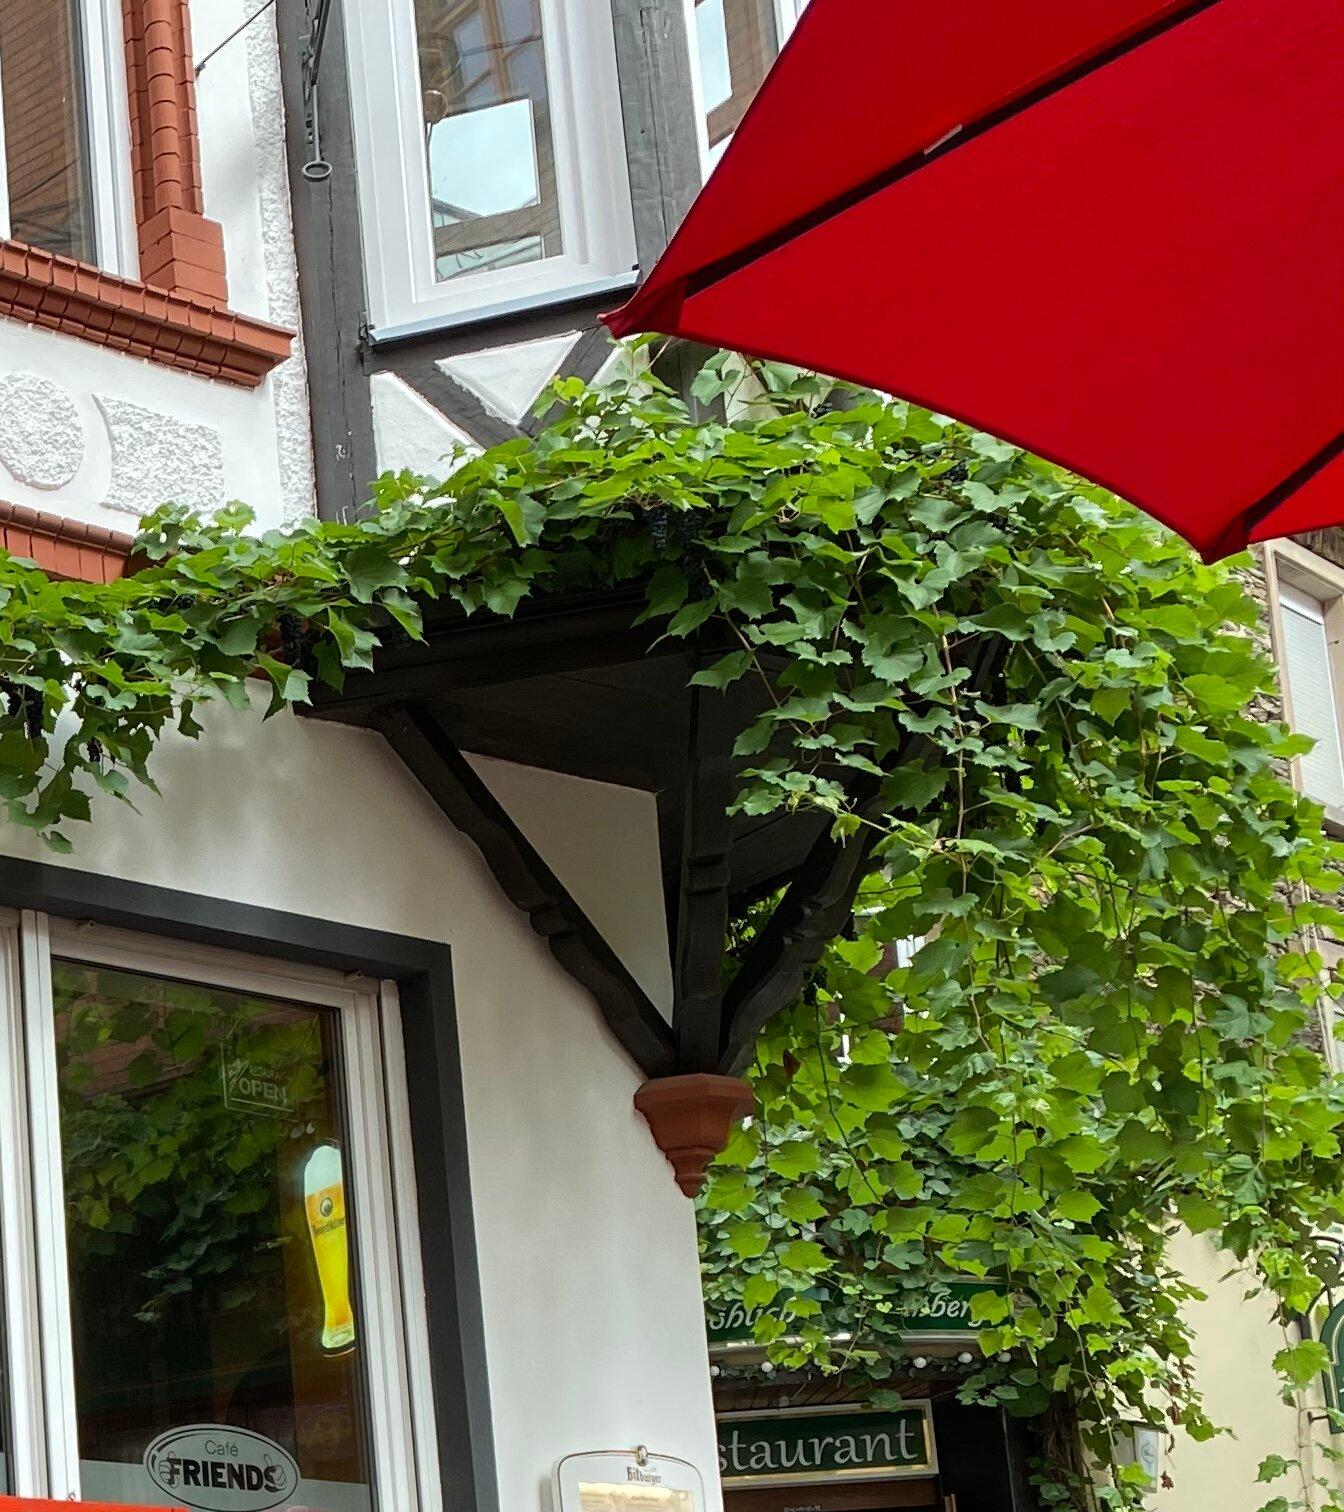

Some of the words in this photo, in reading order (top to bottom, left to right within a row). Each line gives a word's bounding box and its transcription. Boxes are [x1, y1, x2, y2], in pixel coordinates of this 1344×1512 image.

[205, 1440, 239, 1457] Café
[717, 1418, 918, 1472] staurant
[166, 1457, 279, 1493] FRIENDS
